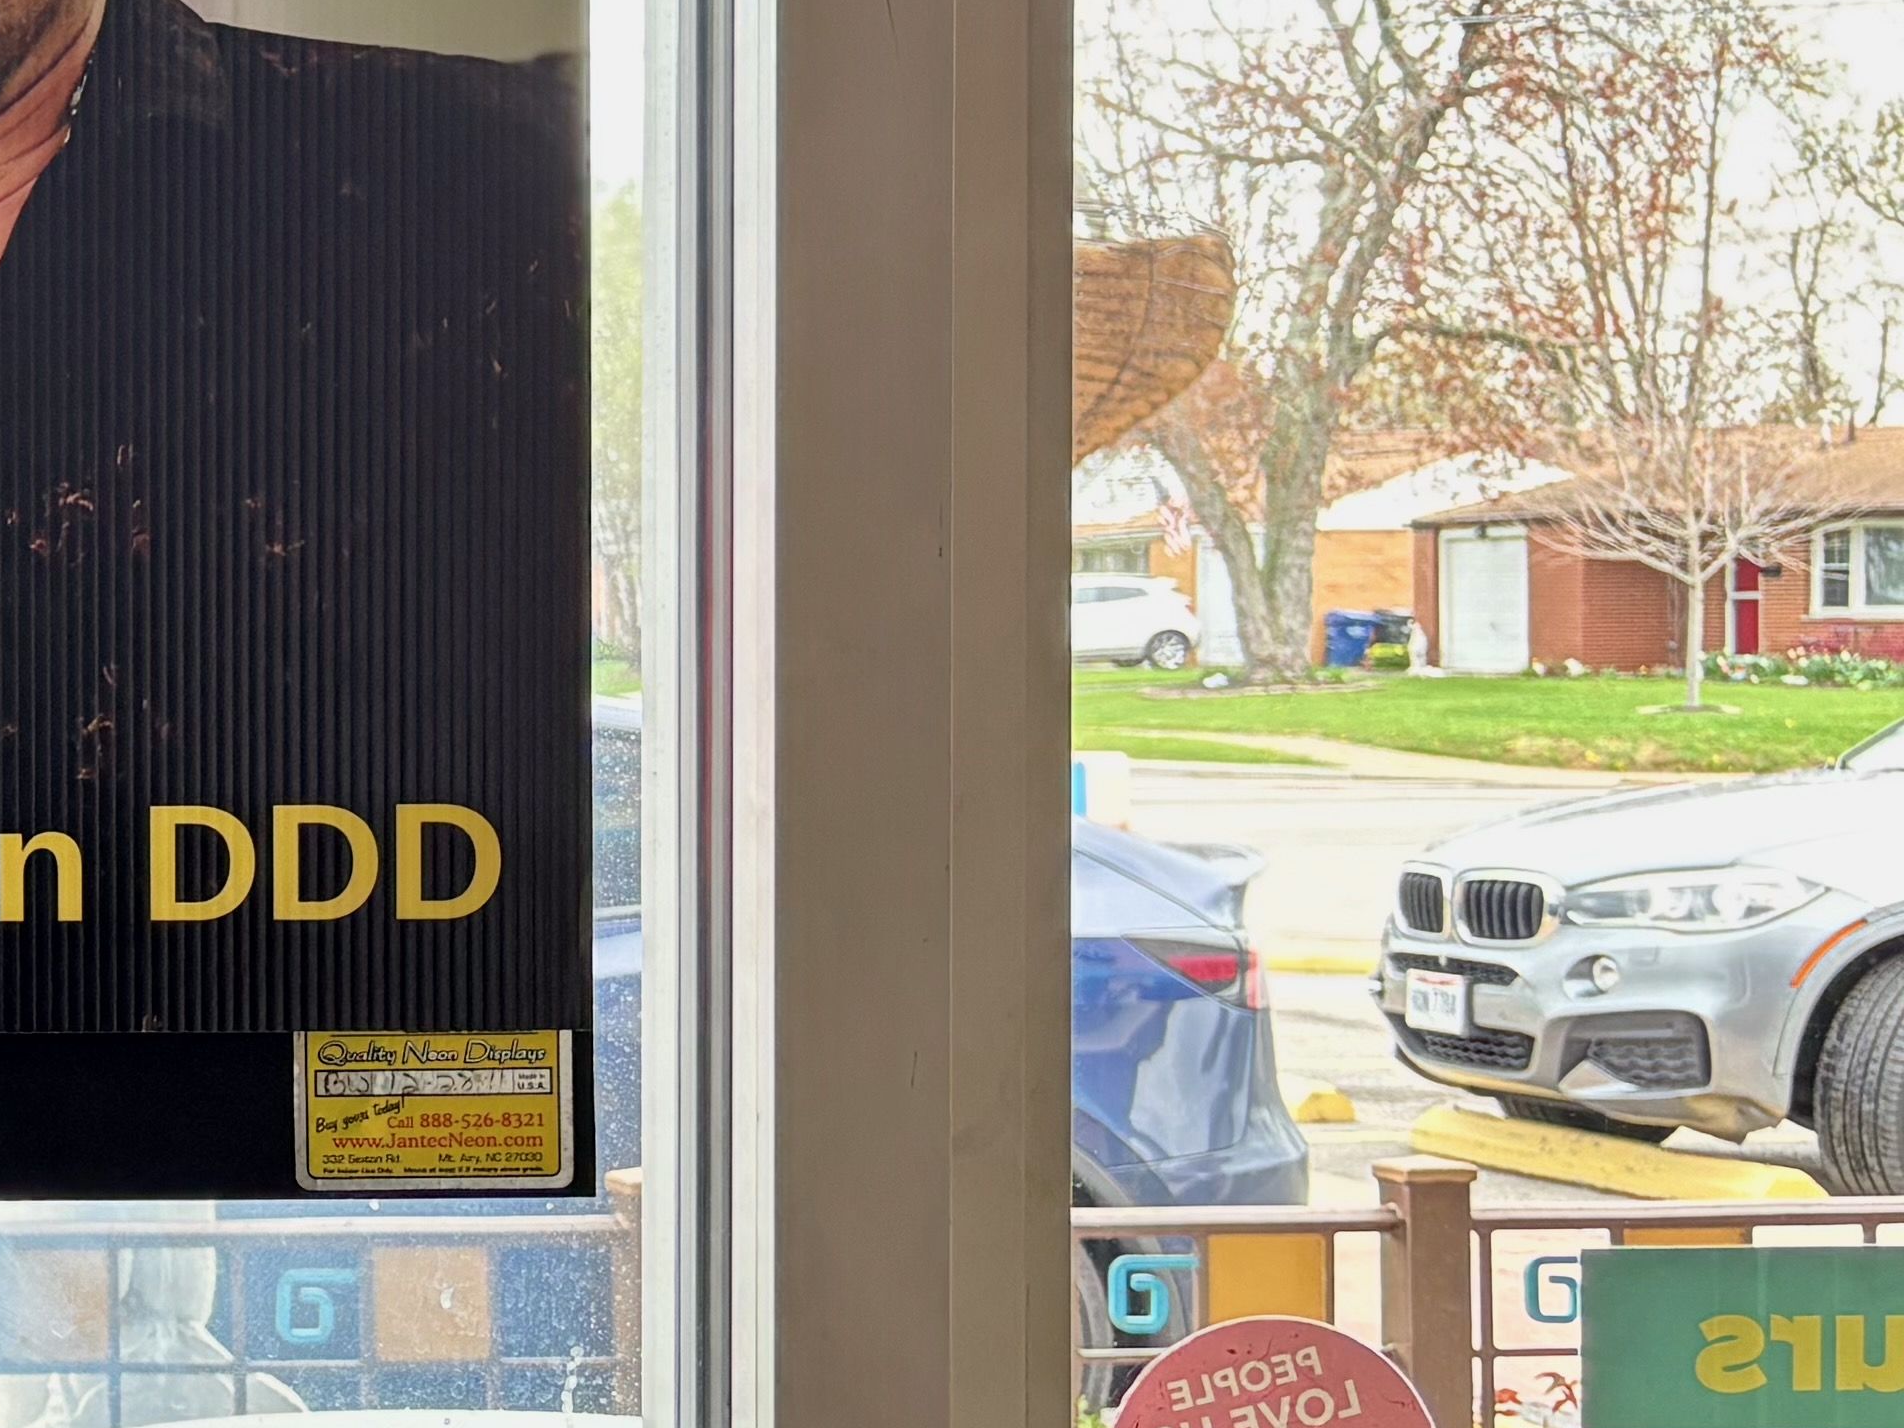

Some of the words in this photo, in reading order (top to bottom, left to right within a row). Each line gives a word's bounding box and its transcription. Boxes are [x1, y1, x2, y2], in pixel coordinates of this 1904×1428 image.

[148, 802, 503, 922] DDD
[318, 1041, 396, 1065] Quality
[401, 1040, 457, 1063] Neon
[464, 1039, 545, 1063] Displays
[316, 1117, 338, 1133] Buy
[387, 1116, 414, 1129] Call
[419, 1113, 545, 1129] 888-526-8321
[332, 1132, 544, 1150] www.JantecNeon.com
